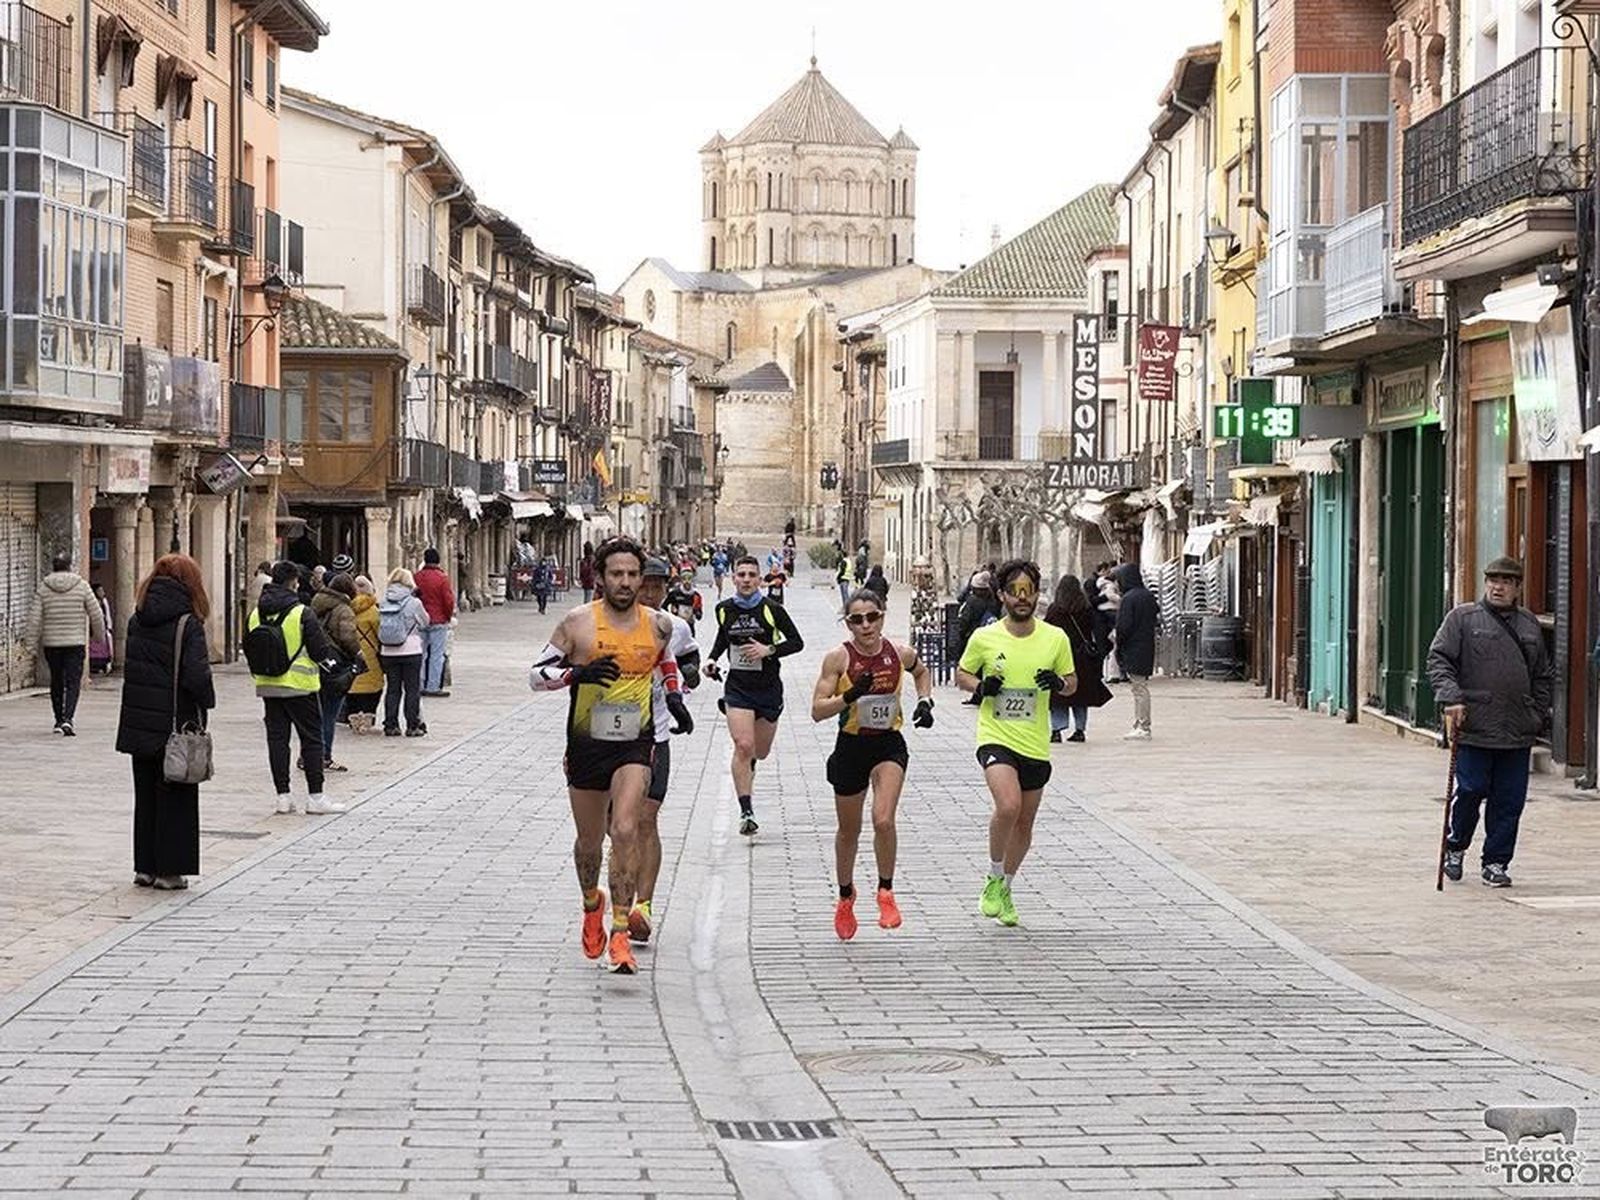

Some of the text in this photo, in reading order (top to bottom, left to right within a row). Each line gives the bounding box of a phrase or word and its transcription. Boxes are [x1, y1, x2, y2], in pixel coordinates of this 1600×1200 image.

[1073, 318, 1097, 459] MESON
[1218, 407, 1294, 437] 11:39
[1048, 464, 1121, 487] ZAMORA
[872, 706, 889, 719] 514
[1006, 698, 1025, 711] 222
[614, 715, 622, 729] 5
